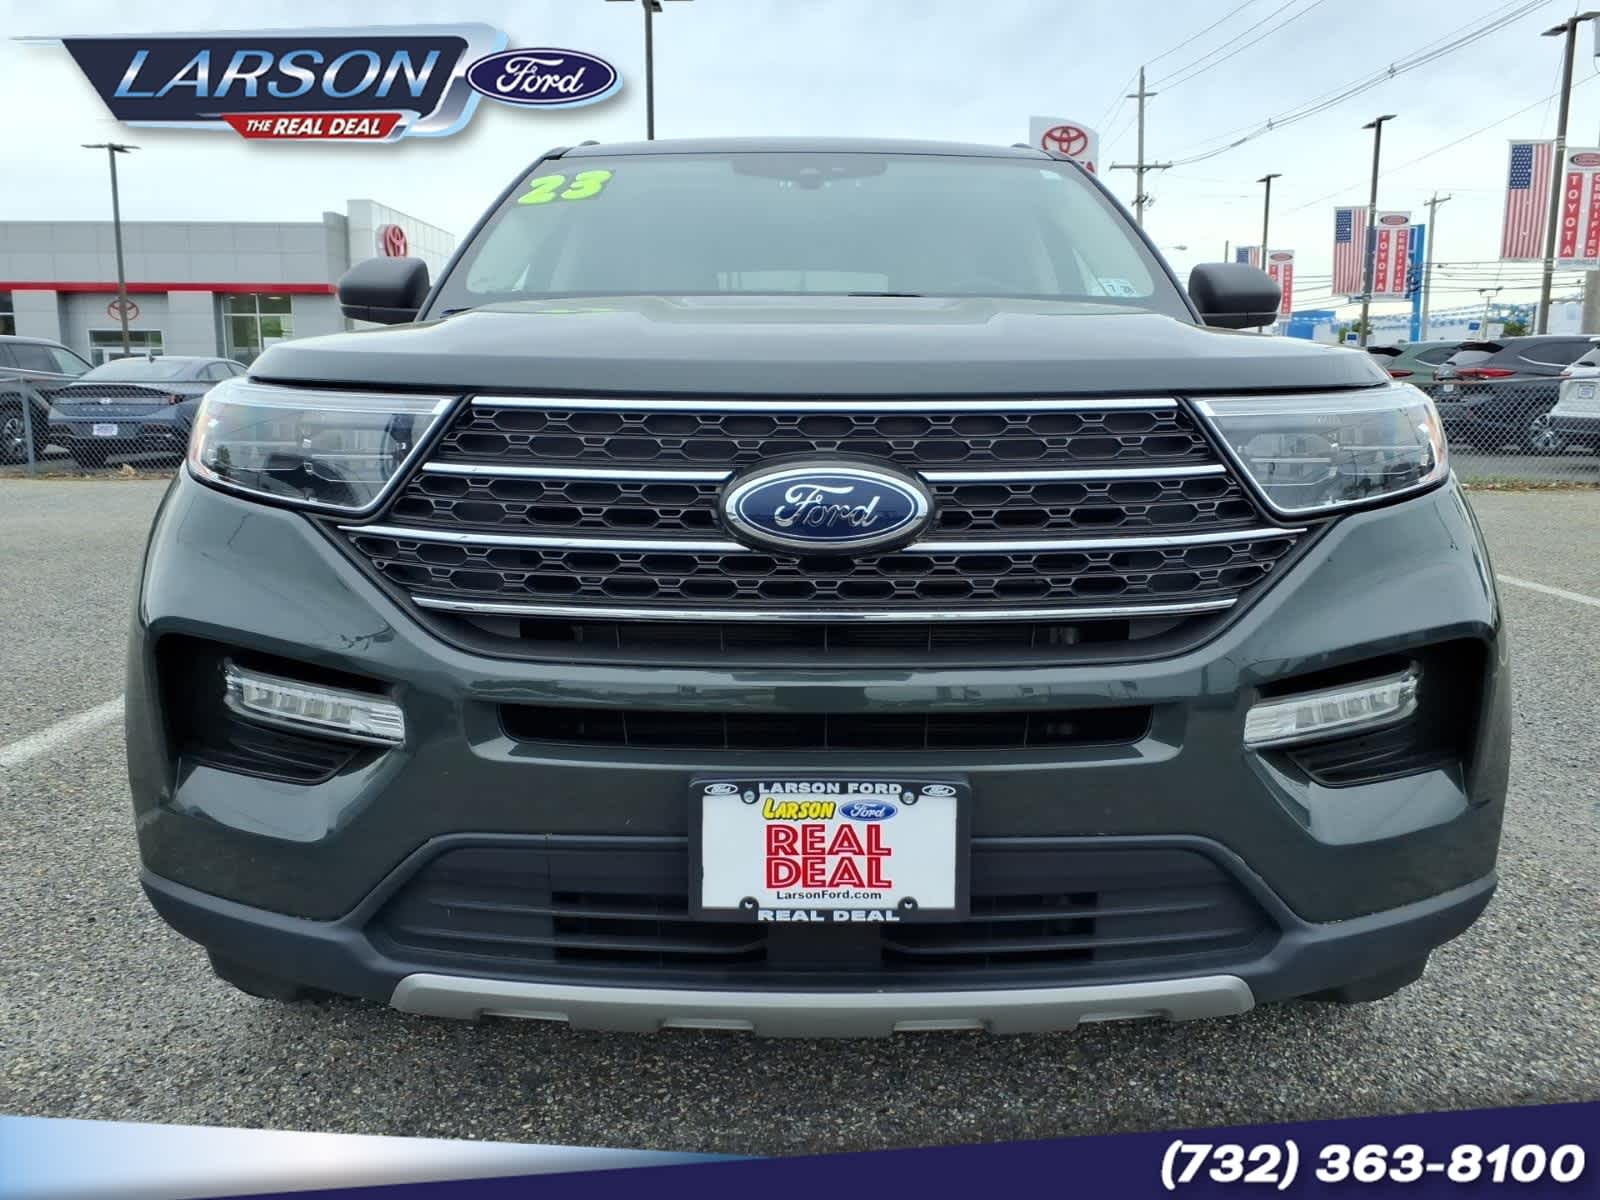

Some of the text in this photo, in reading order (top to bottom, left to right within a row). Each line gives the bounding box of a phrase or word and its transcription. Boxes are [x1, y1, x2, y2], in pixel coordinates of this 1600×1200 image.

[517, 170, 613, 205] 23
[1562, 175, 1579, 256] TOYOTA
[1376, 231, 1388, 291] TOYOTA
[774, 484, 881, 527] Ford
[758, 783, 902, 794] LARSON FORD
[762, 797, 887, 821] LARSON Ford
[766, 824, 892, 856] REAL
[766, 856, 892, 888] DEAL
[776, 889, 882, 900] LarsonFord.com
[758, 910, 900, 921] REAL DEAL
